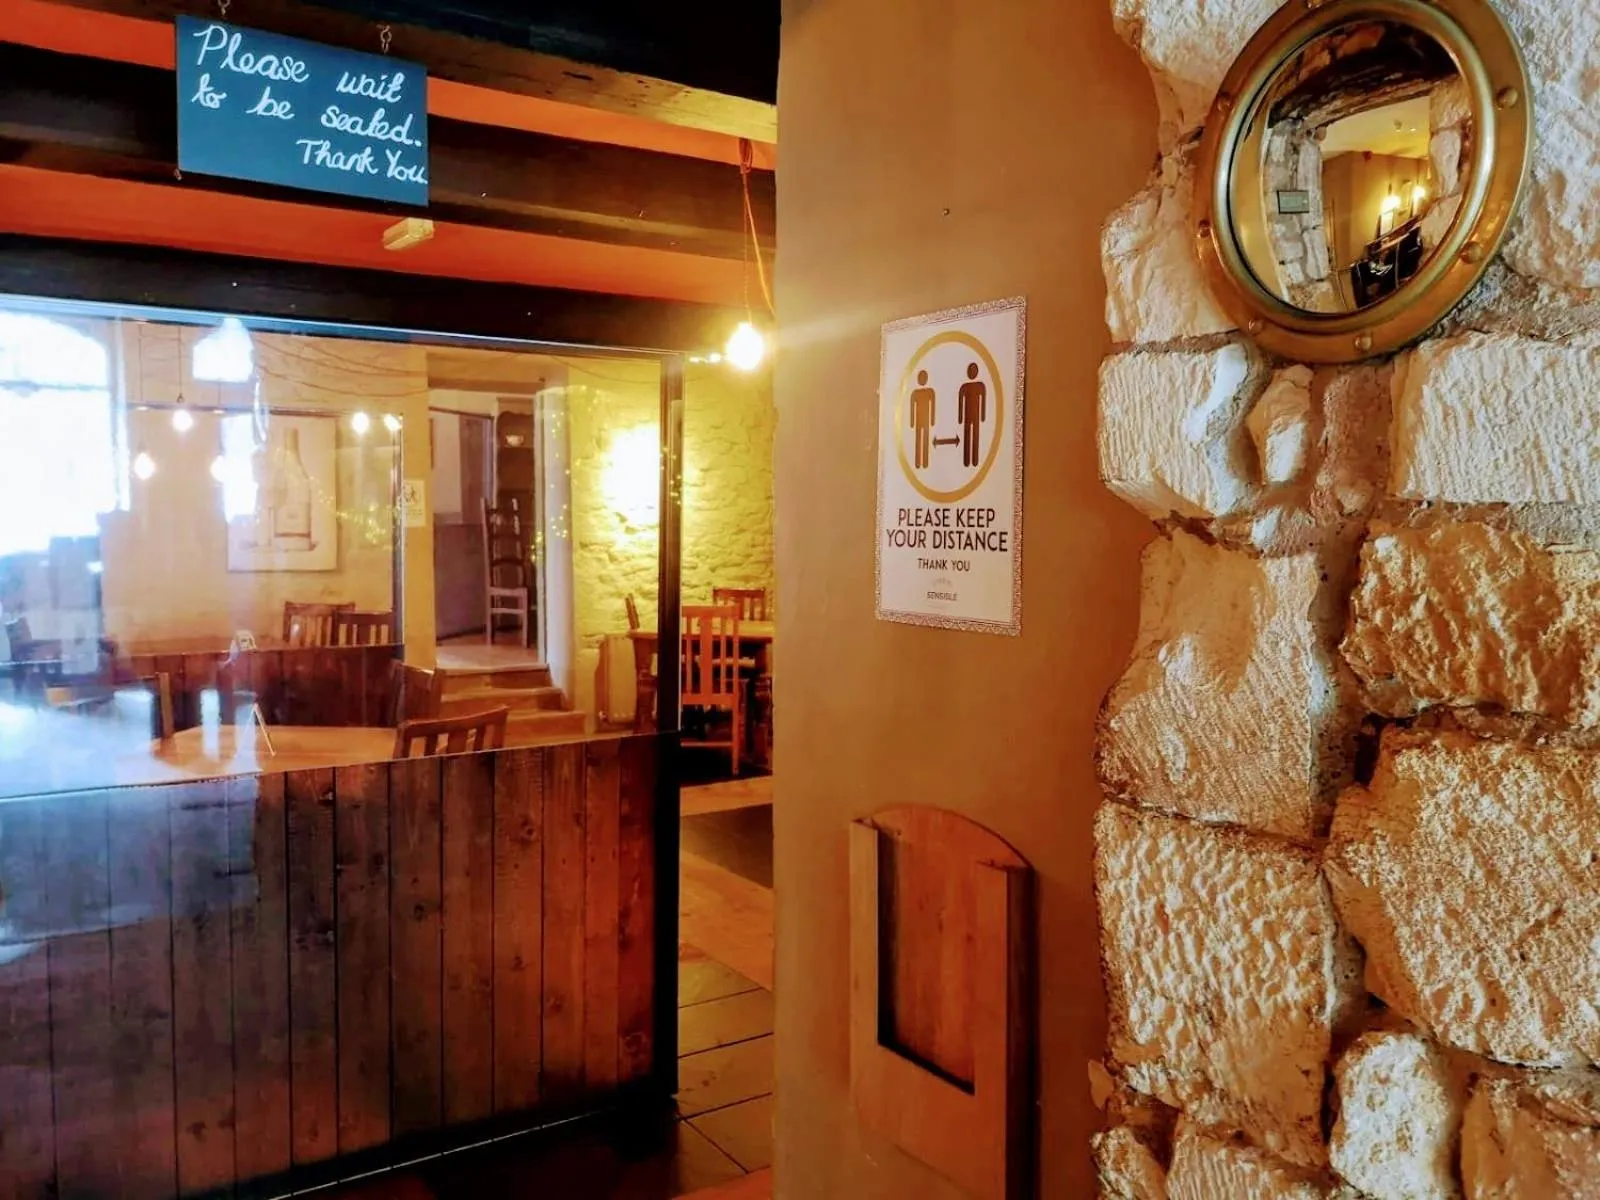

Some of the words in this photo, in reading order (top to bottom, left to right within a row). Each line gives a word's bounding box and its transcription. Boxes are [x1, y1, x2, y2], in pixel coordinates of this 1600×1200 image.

[193, 24, 310, 82] Please
[336, 72, 405, 103] wait
[191, 73, 227, 108] to
[246, 86, 295, 120] be
[321, 105, 422, 147] seated.
[296, 139, 379, 175] Thank
[385, 146, 428, 184] You
[898, 508, 950, 527] PLEASE
[956, 508, 995, 528] KEEP
[886, 529, 927, 548] YOUR
[932, 530, 1008, 552] DISTANCE
[918, 558, 948, 571] THANK
[951, 560, 970, 572] YOU
